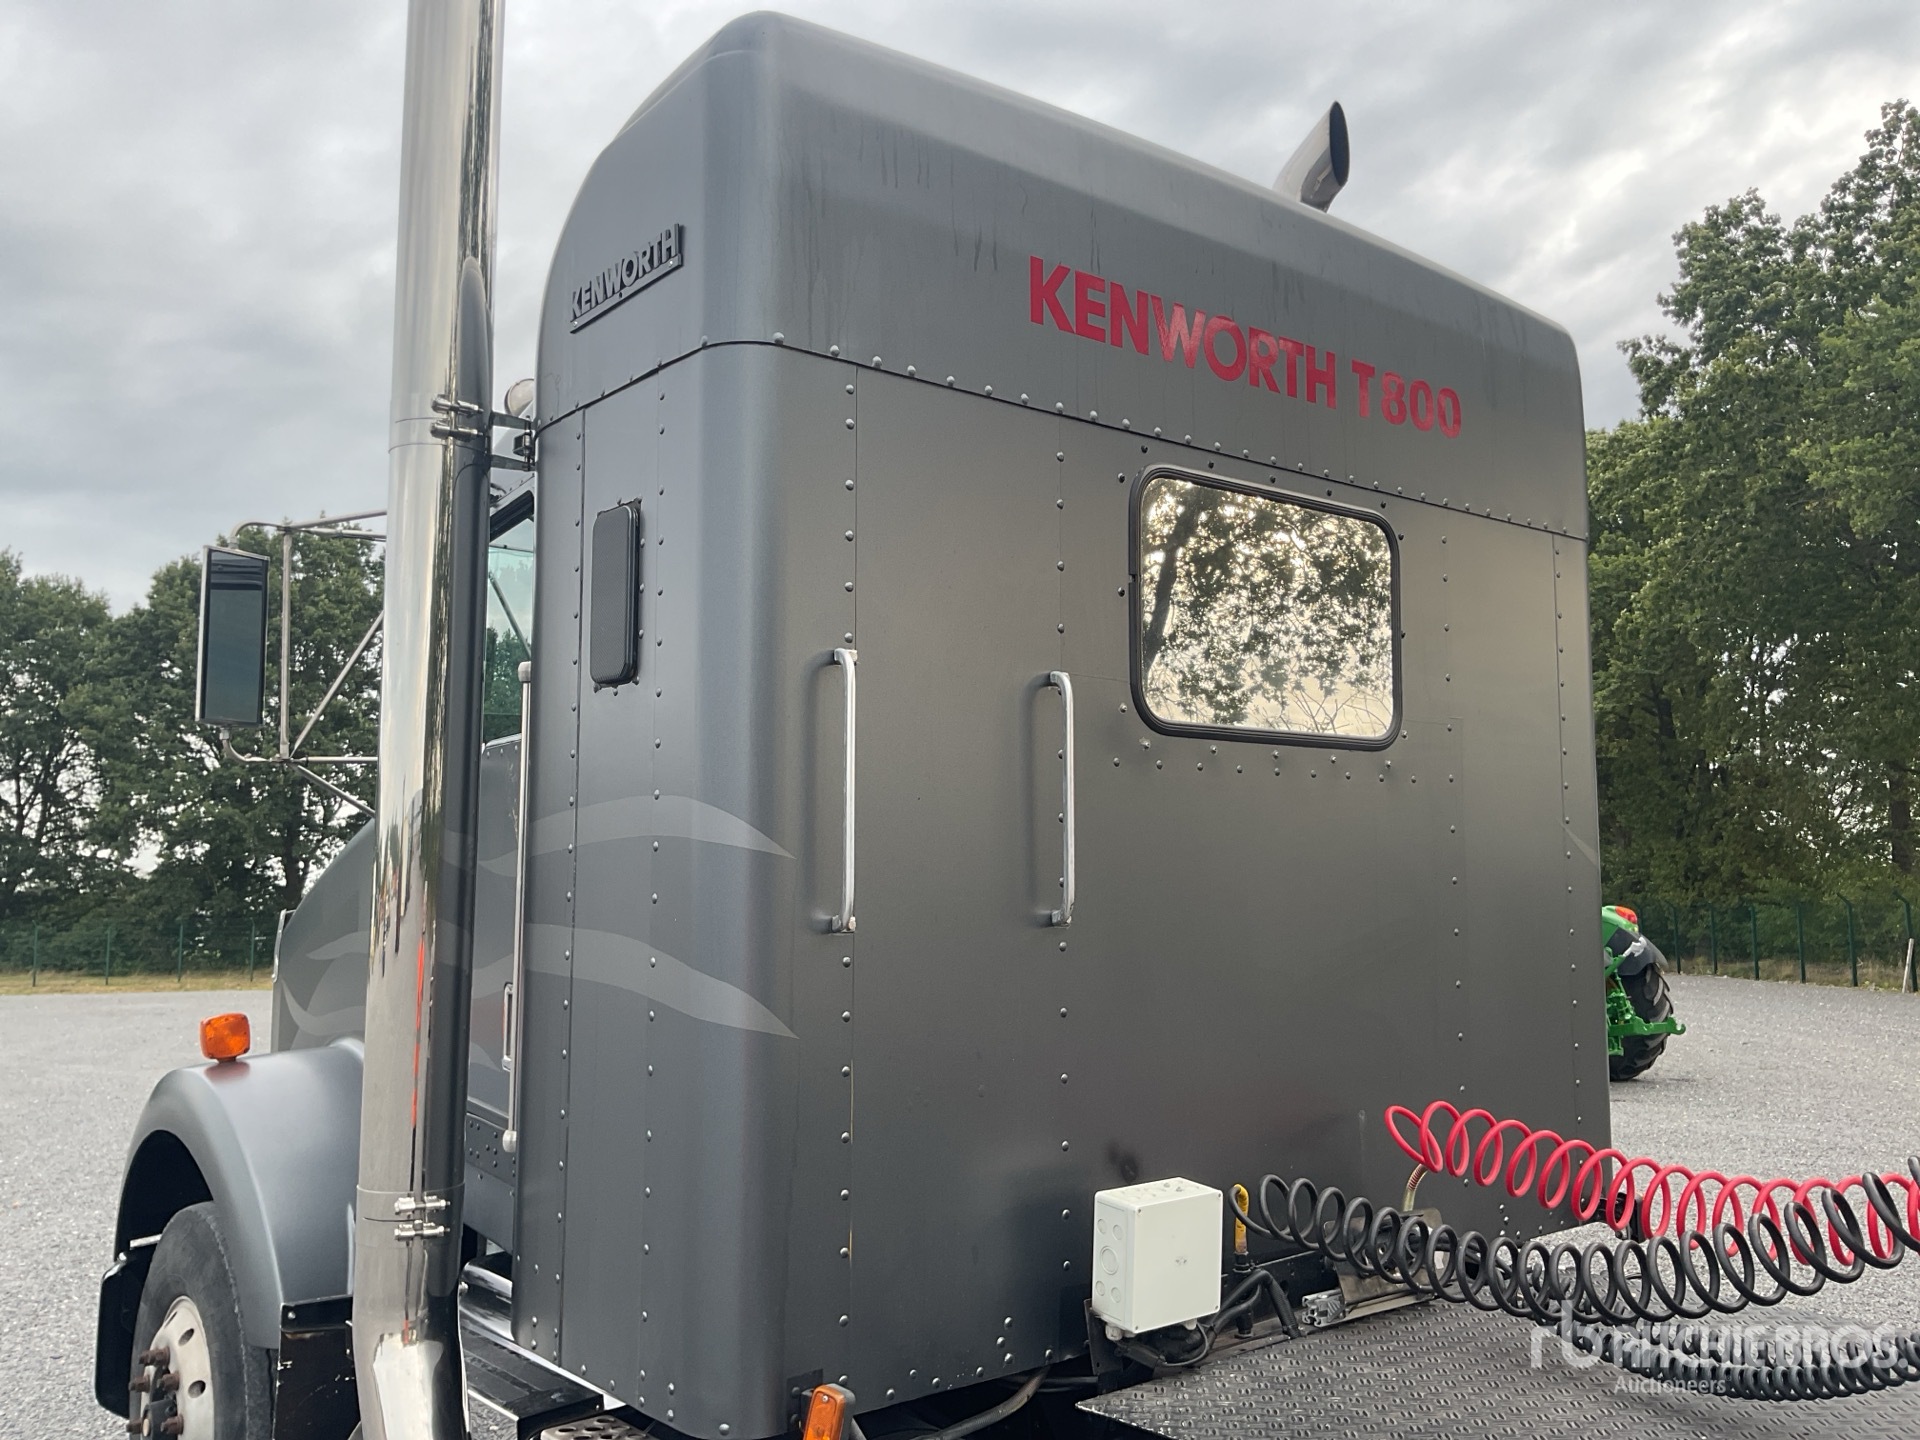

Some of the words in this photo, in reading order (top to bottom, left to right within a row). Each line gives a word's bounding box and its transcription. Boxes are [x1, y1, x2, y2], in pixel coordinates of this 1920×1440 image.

[570, 223, 684, 321] KENWORTH
[1030, 256, 1336, 409] KENWORTH
[1352, 359, 1461, 438] T800
